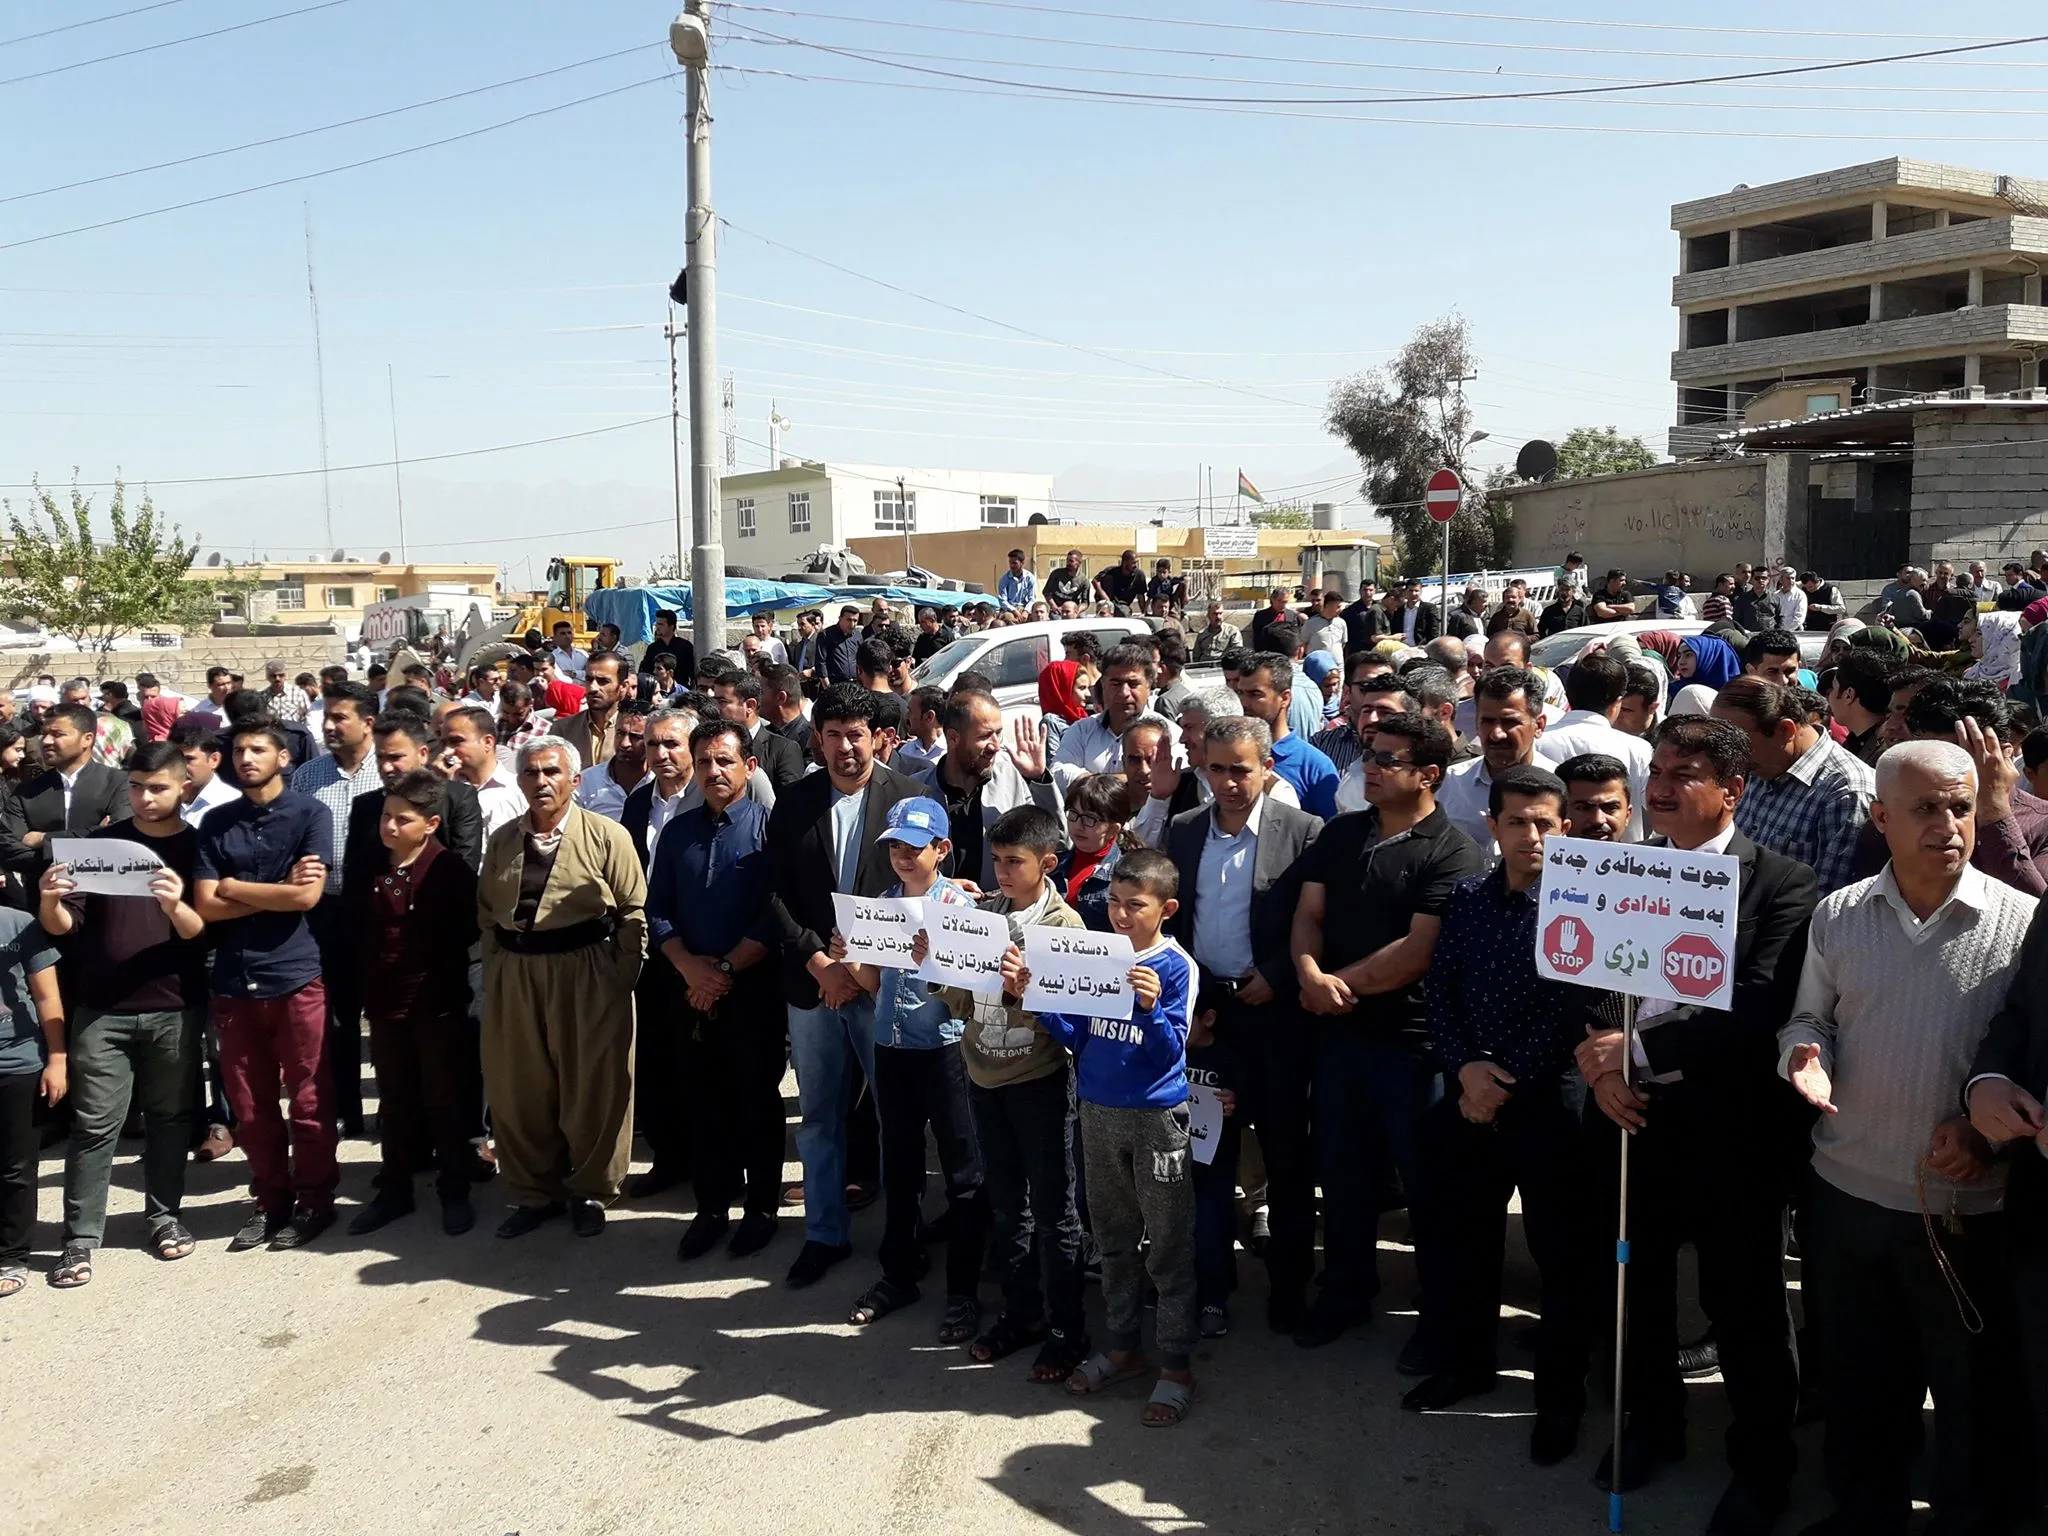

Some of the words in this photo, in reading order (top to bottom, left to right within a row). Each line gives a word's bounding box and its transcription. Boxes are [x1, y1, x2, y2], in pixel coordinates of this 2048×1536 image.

[1680, 866, 1732, 890] جوت
[1595, 893, 1607, 911] و
[877, 937, 914, 953] عورتان
[1551, 952, 1584, 969] STOP
[1665, 951, 1723, 981] STOP
[991, 1049, 1007, 1058] THE
[1007, 1046, 1033, 1058] GAME
[1185, 1067, 1219, 1086] TIC
